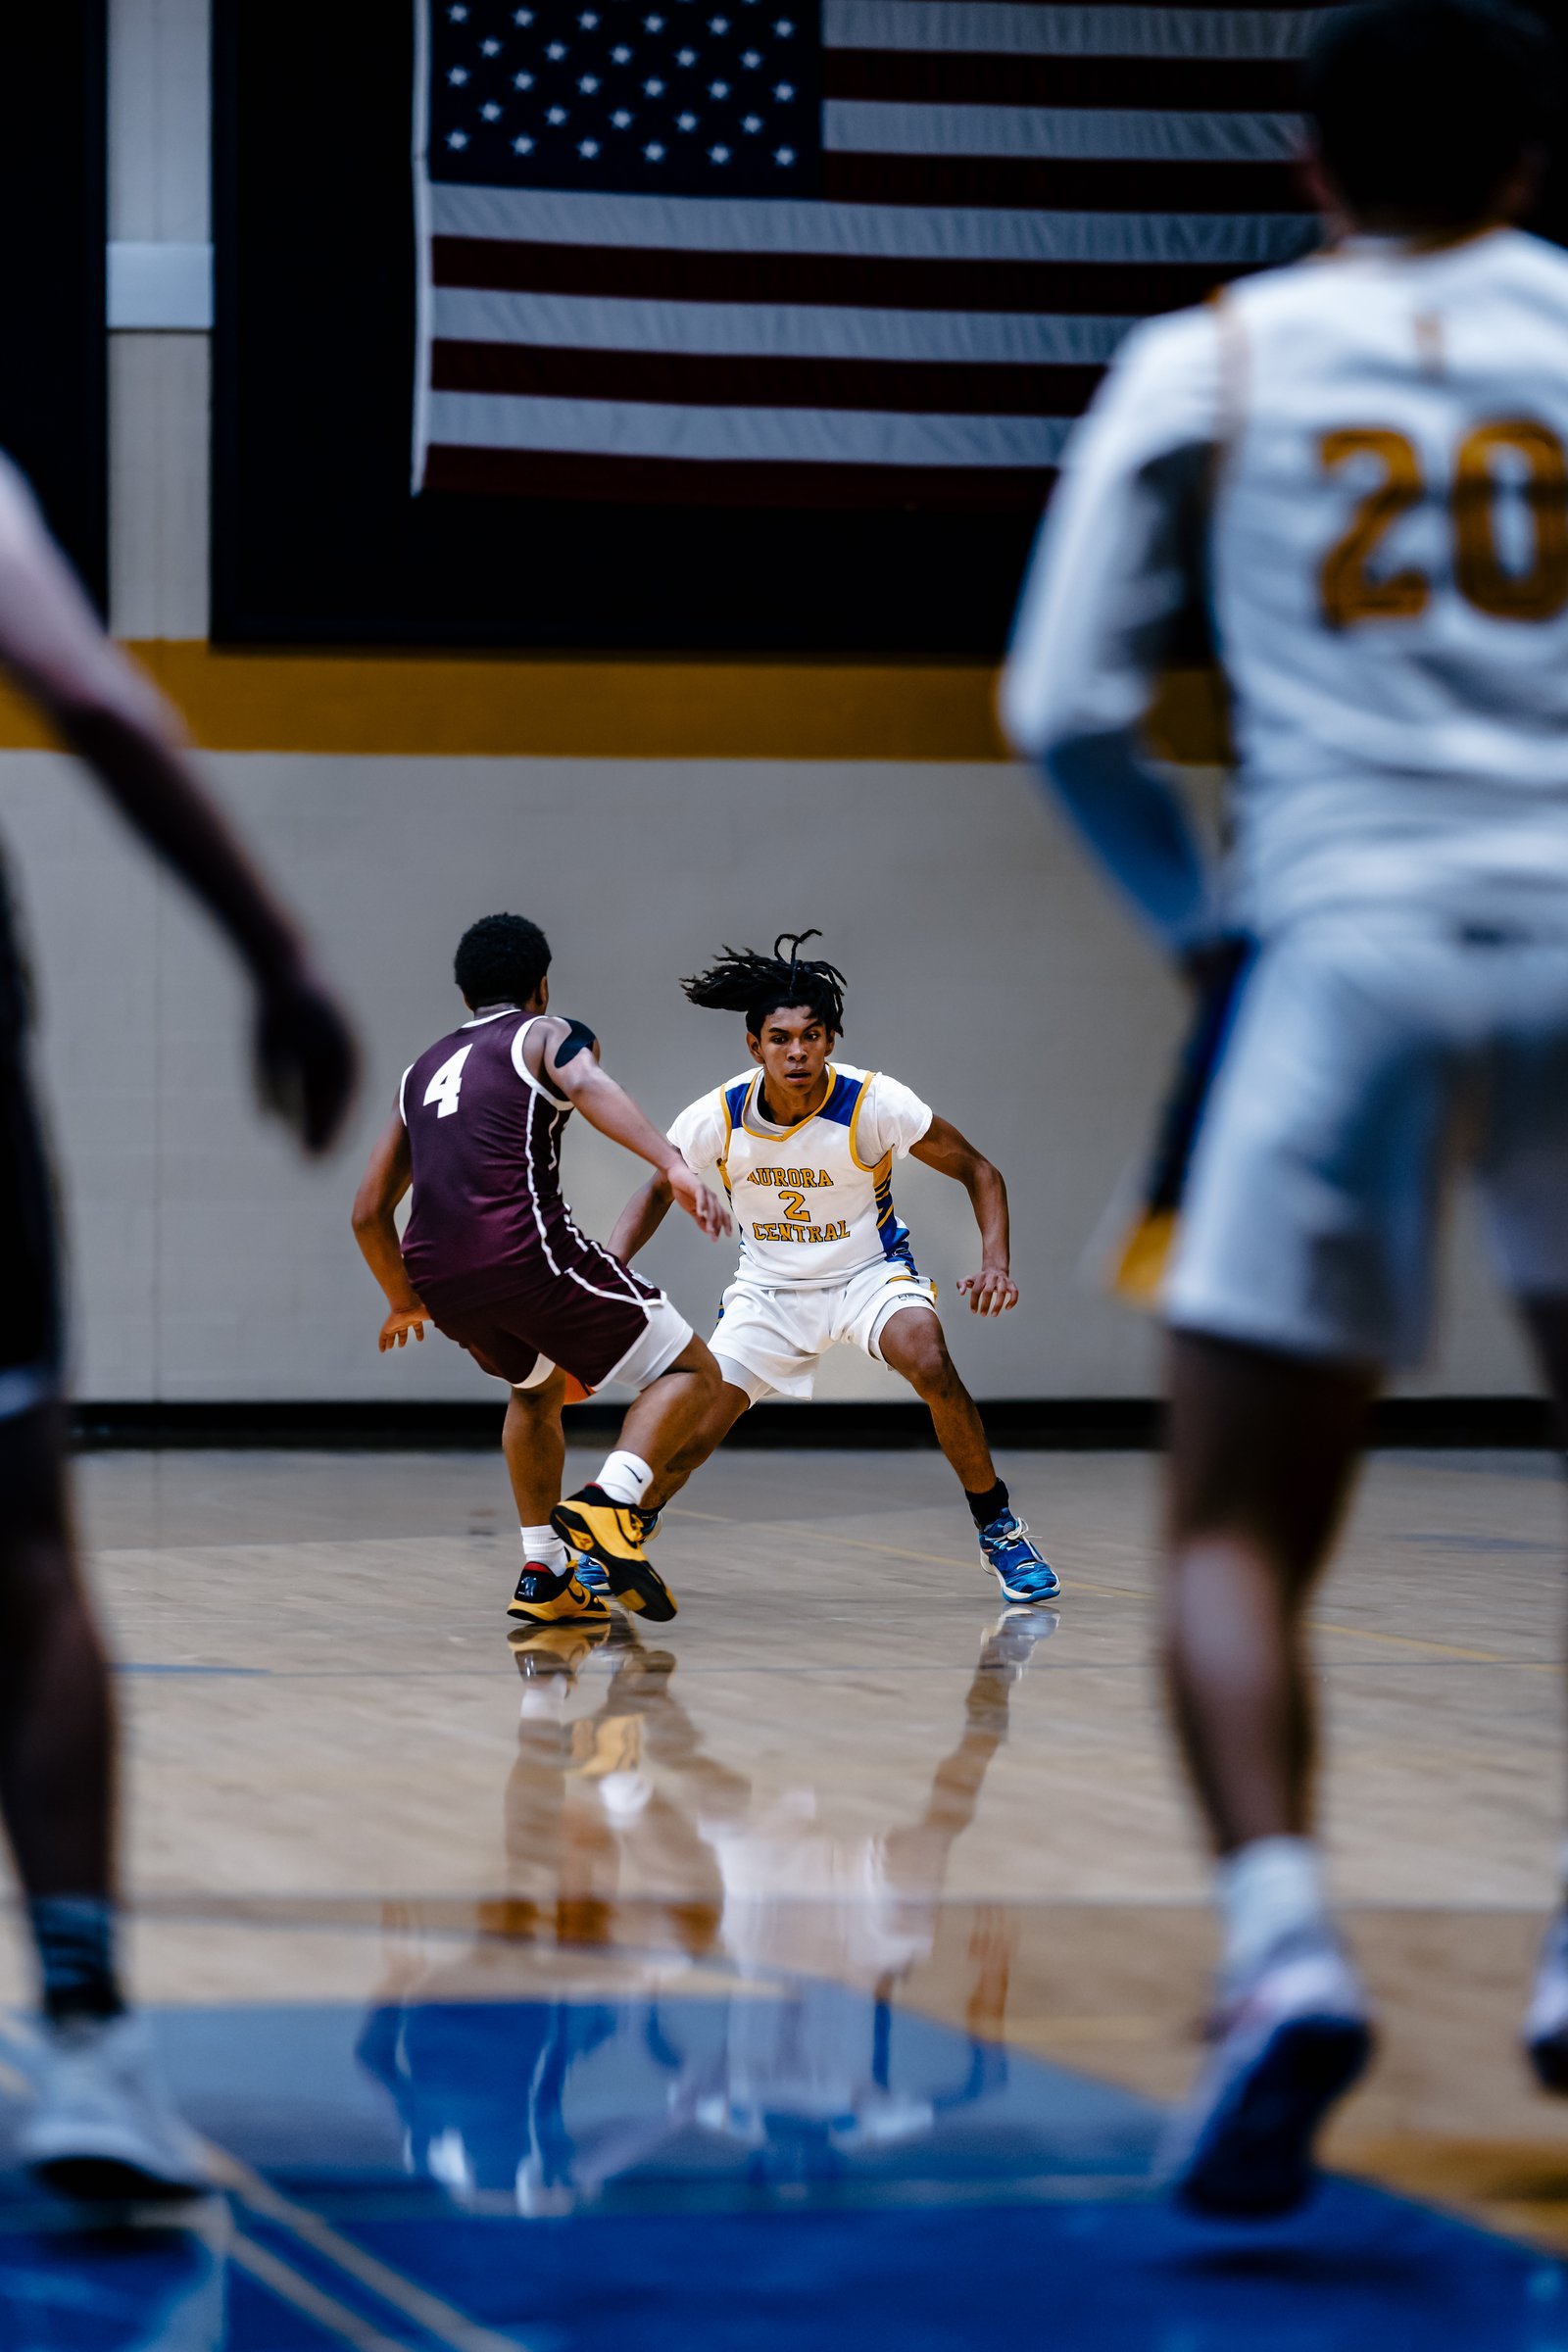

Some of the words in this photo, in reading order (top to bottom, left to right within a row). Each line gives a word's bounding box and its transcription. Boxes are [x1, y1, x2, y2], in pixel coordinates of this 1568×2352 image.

[1317, 418, 1568, 629] 20
[422, 1043, 473, 1119] 4
[747, 1167, 834, 1188] AURORA
[778, 1190, 810, 1222] 2
[752, 1220, 851, 1243] CENTRAL
